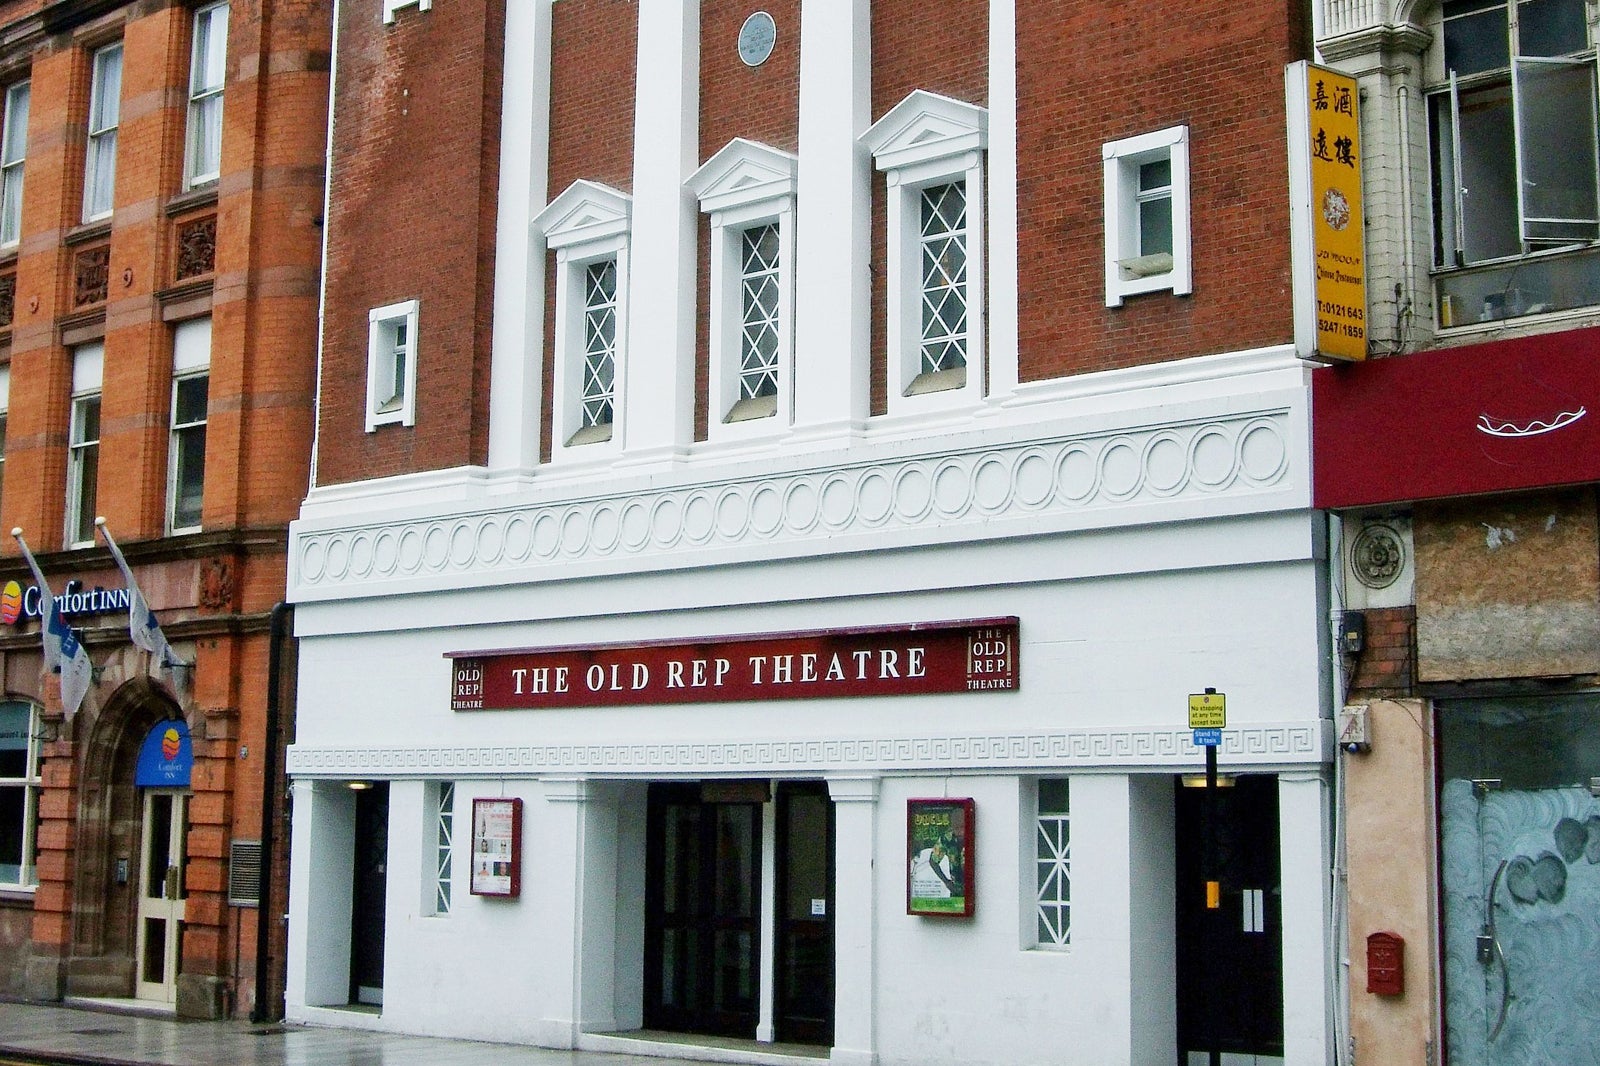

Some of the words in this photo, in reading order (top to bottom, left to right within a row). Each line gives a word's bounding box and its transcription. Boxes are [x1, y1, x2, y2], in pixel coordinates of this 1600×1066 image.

[1347, 307, 1363, 320] 643
[99, 589, 130, 610] INN
[973, 641, 1006, 656] OLD
[512, 667, 569, 695] THE
[586, 663, 649, 692] OLD
[667, 658, 730, 688] REP
[749, 648, 926, 685] THEATRE
[974, 659, 1006, 673] REP
[457, 669, 480, 682] OLD
[458, 684, 479, 696] REP
[967, 678, 1012, 690] THEATRE
[452, 700, 483, 709] THEATRE
